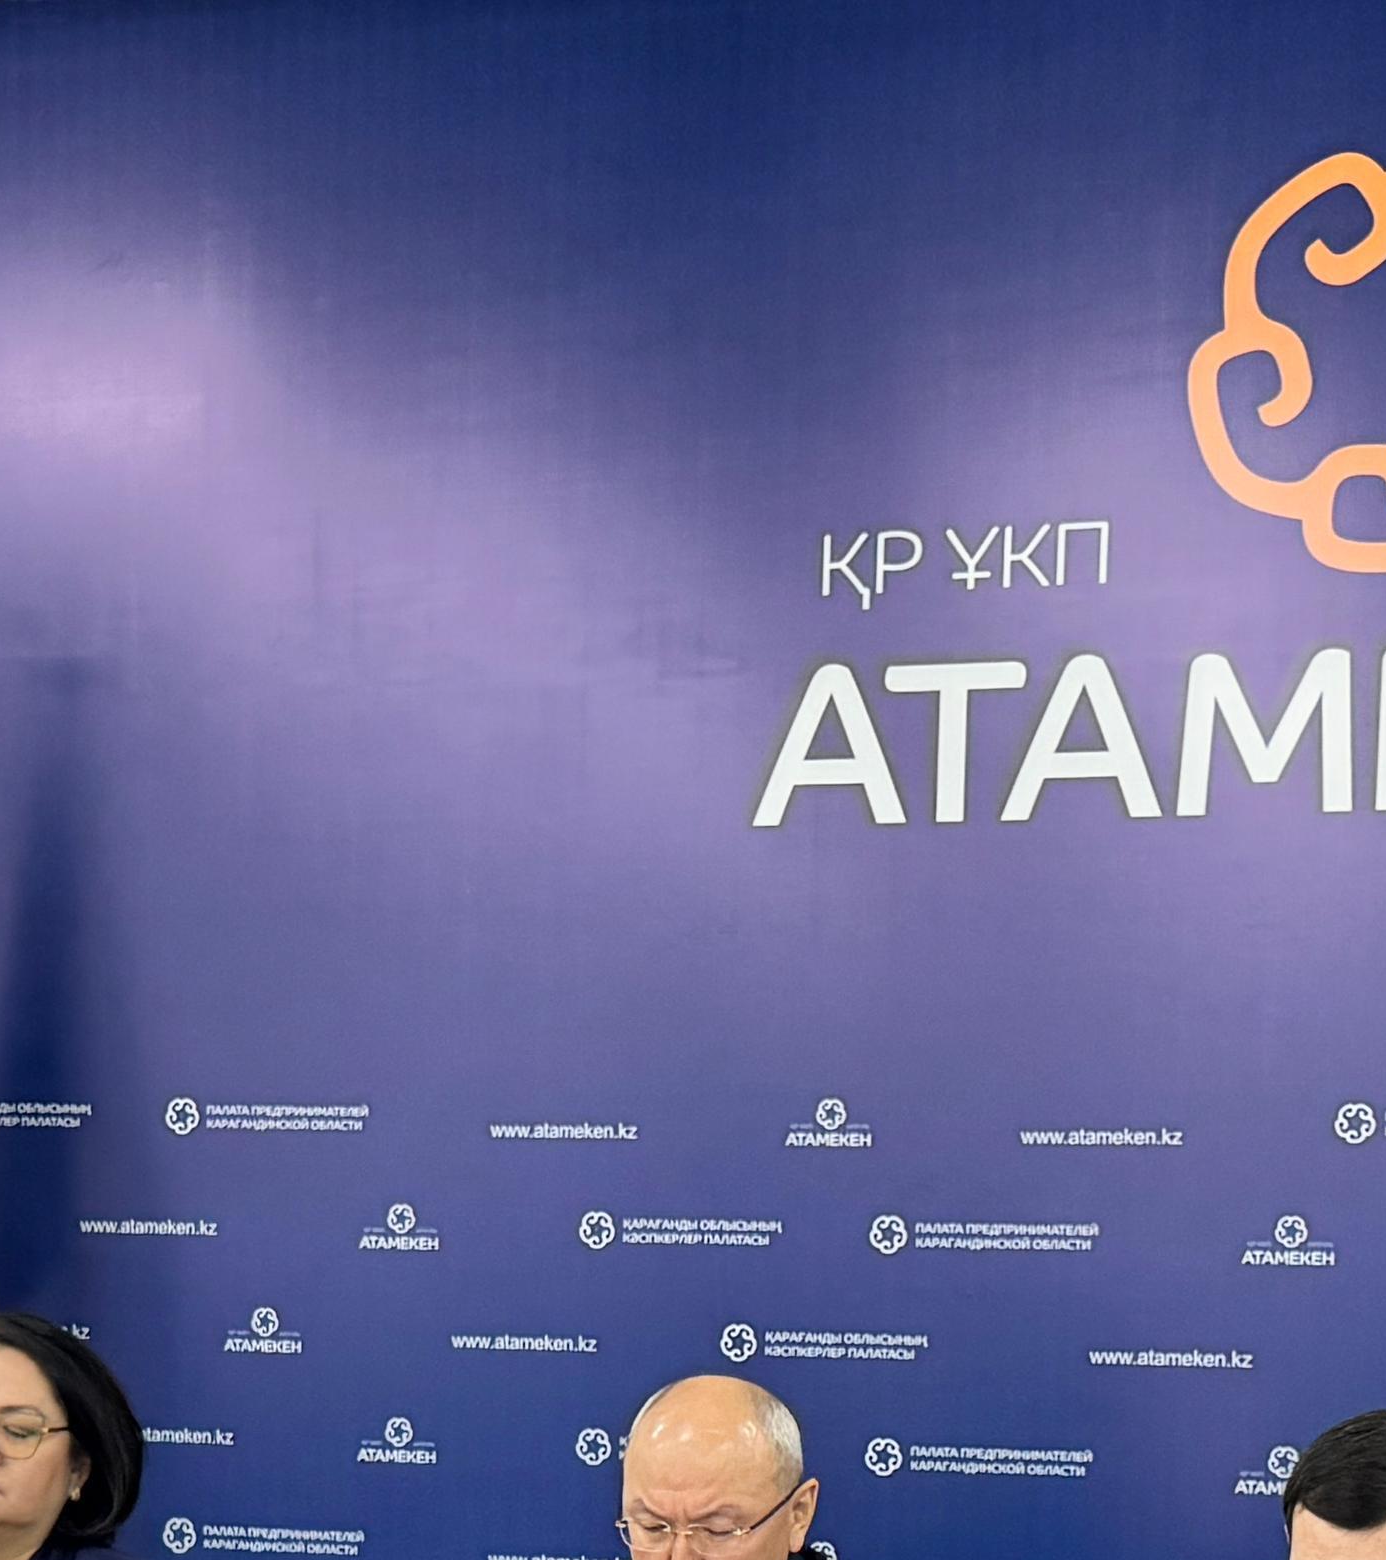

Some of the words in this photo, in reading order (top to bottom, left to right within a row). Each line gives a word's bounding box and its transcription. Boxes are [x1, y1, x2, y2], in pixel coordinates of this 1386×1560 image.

[822, 531, 922, 610] ҚР
[206, 1105, 250, 1116] ПАЛАТА
[311, 1119, 363, 1131] ОБЛАСТИ
[490, 1123, 637, 1139] www.atameken.kz
[785, 1133, 871, 1146] АТАМЕКЕН
[1020, 1128, 1182, 1145] www.atameken.kz
[80, 1219, 217, 1236] www.atameken.kz
[915, 1222, 964, 1235] ПАЛАТА
[359, 1236, 439, 1250] АТАМЕКЕН
[1033, 1238, 1092, 1251] ОБЛАСТИ
[1241, 1250, 1335, 1265] АТАМЕКЕН
[224, 1339, 301, 1353] АТАМЕКЕН
[451, 1335, 597, 1352] www.atameken.kz
[1089, 1350, 1253, 1368] www.atameken.kz
[143, 1426, 235, 1446] tameken.kz
[357, 1448, 436, 1463] АТАМЕКЕН
[910, 1446, 959, 1459] ПАЛАТА
[1027, 1462, 1086, 1476] ОБЛАСТИ
[1235, 1479, 1284, 1496] АТАМ
[204, 1525, 247, 1537] ПАЛАТА
[307, 1542, 359, 1556] ОБЛАСТИ
